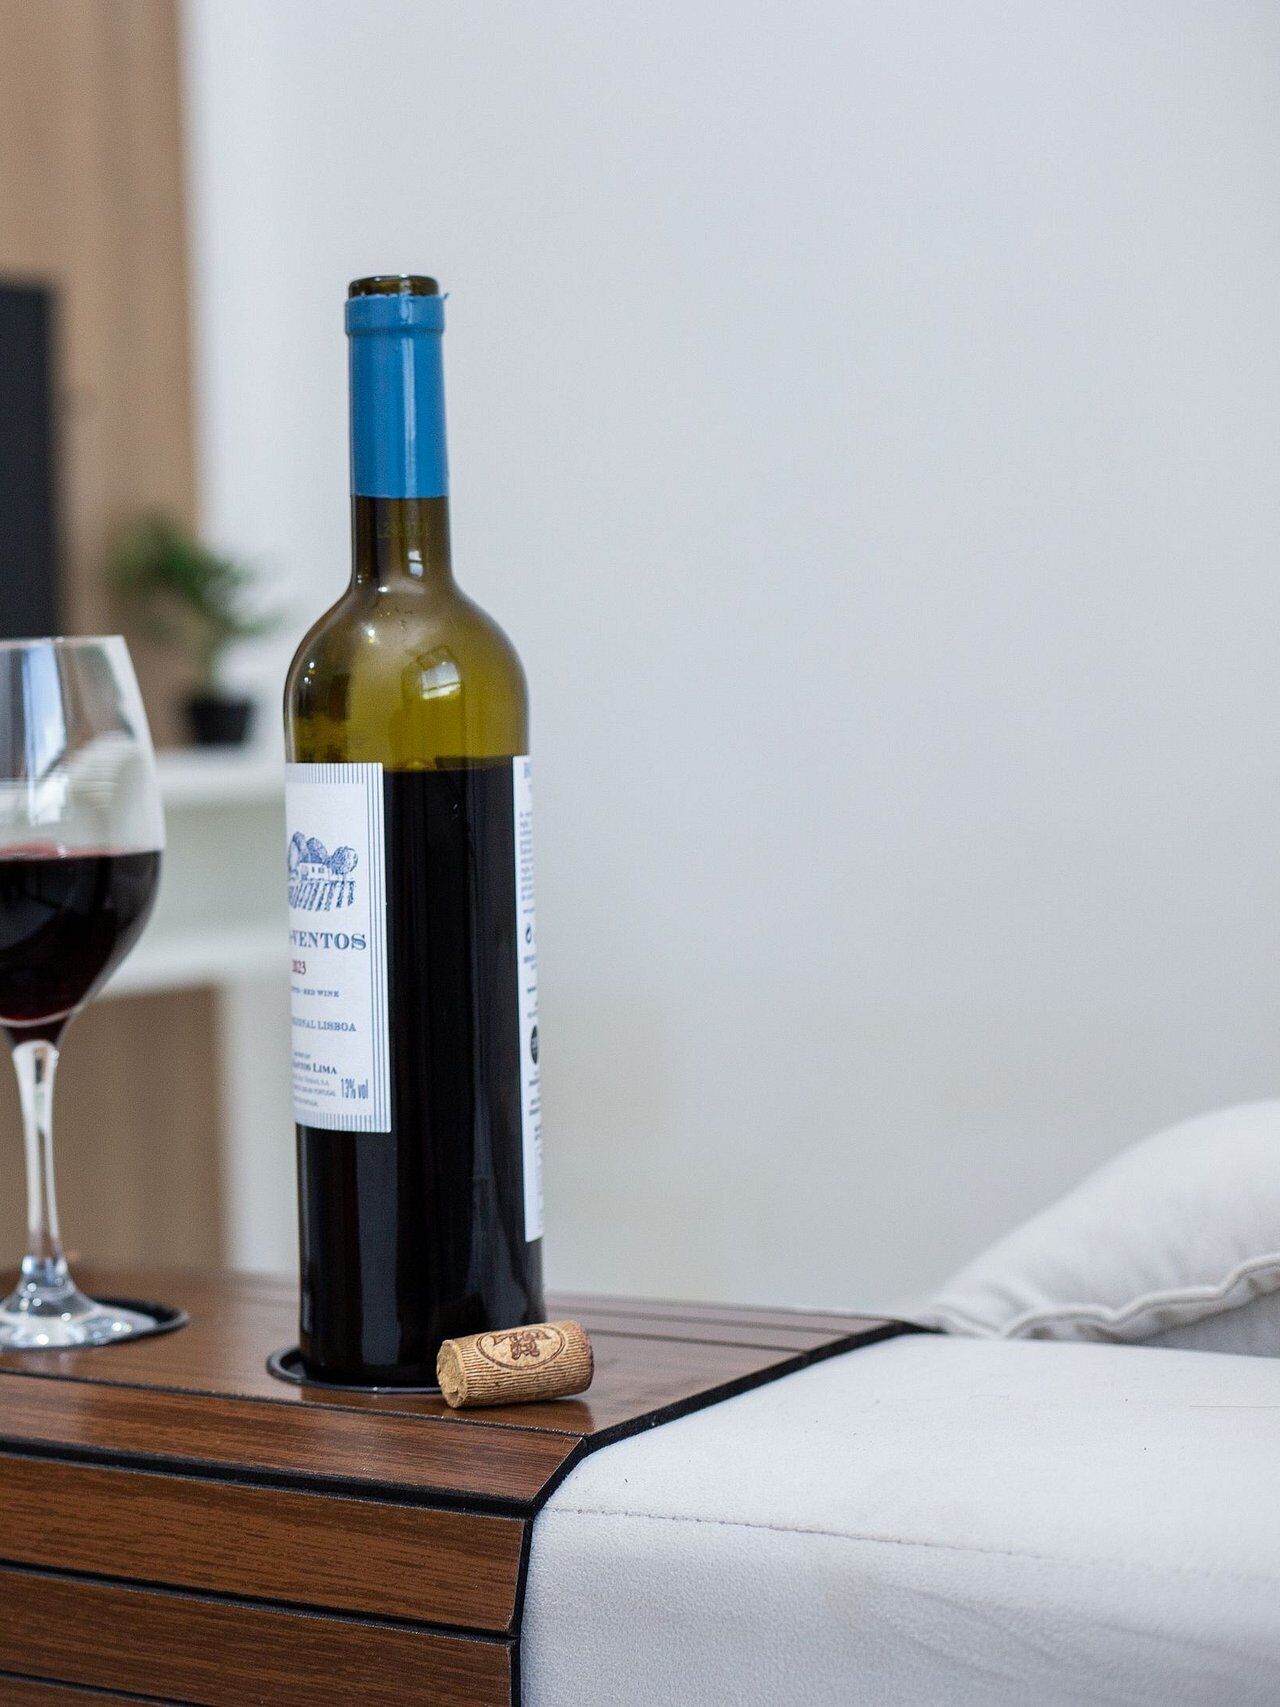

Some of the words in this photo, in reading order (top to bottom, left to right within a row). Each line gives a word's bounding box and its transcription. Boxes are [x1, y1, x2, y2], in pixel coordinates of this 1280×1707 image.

[317, 989, 340, 998] WINE
[317, 1020, 357, 1032] LISBOA
[340, 1077, 357, 1100] 13%
